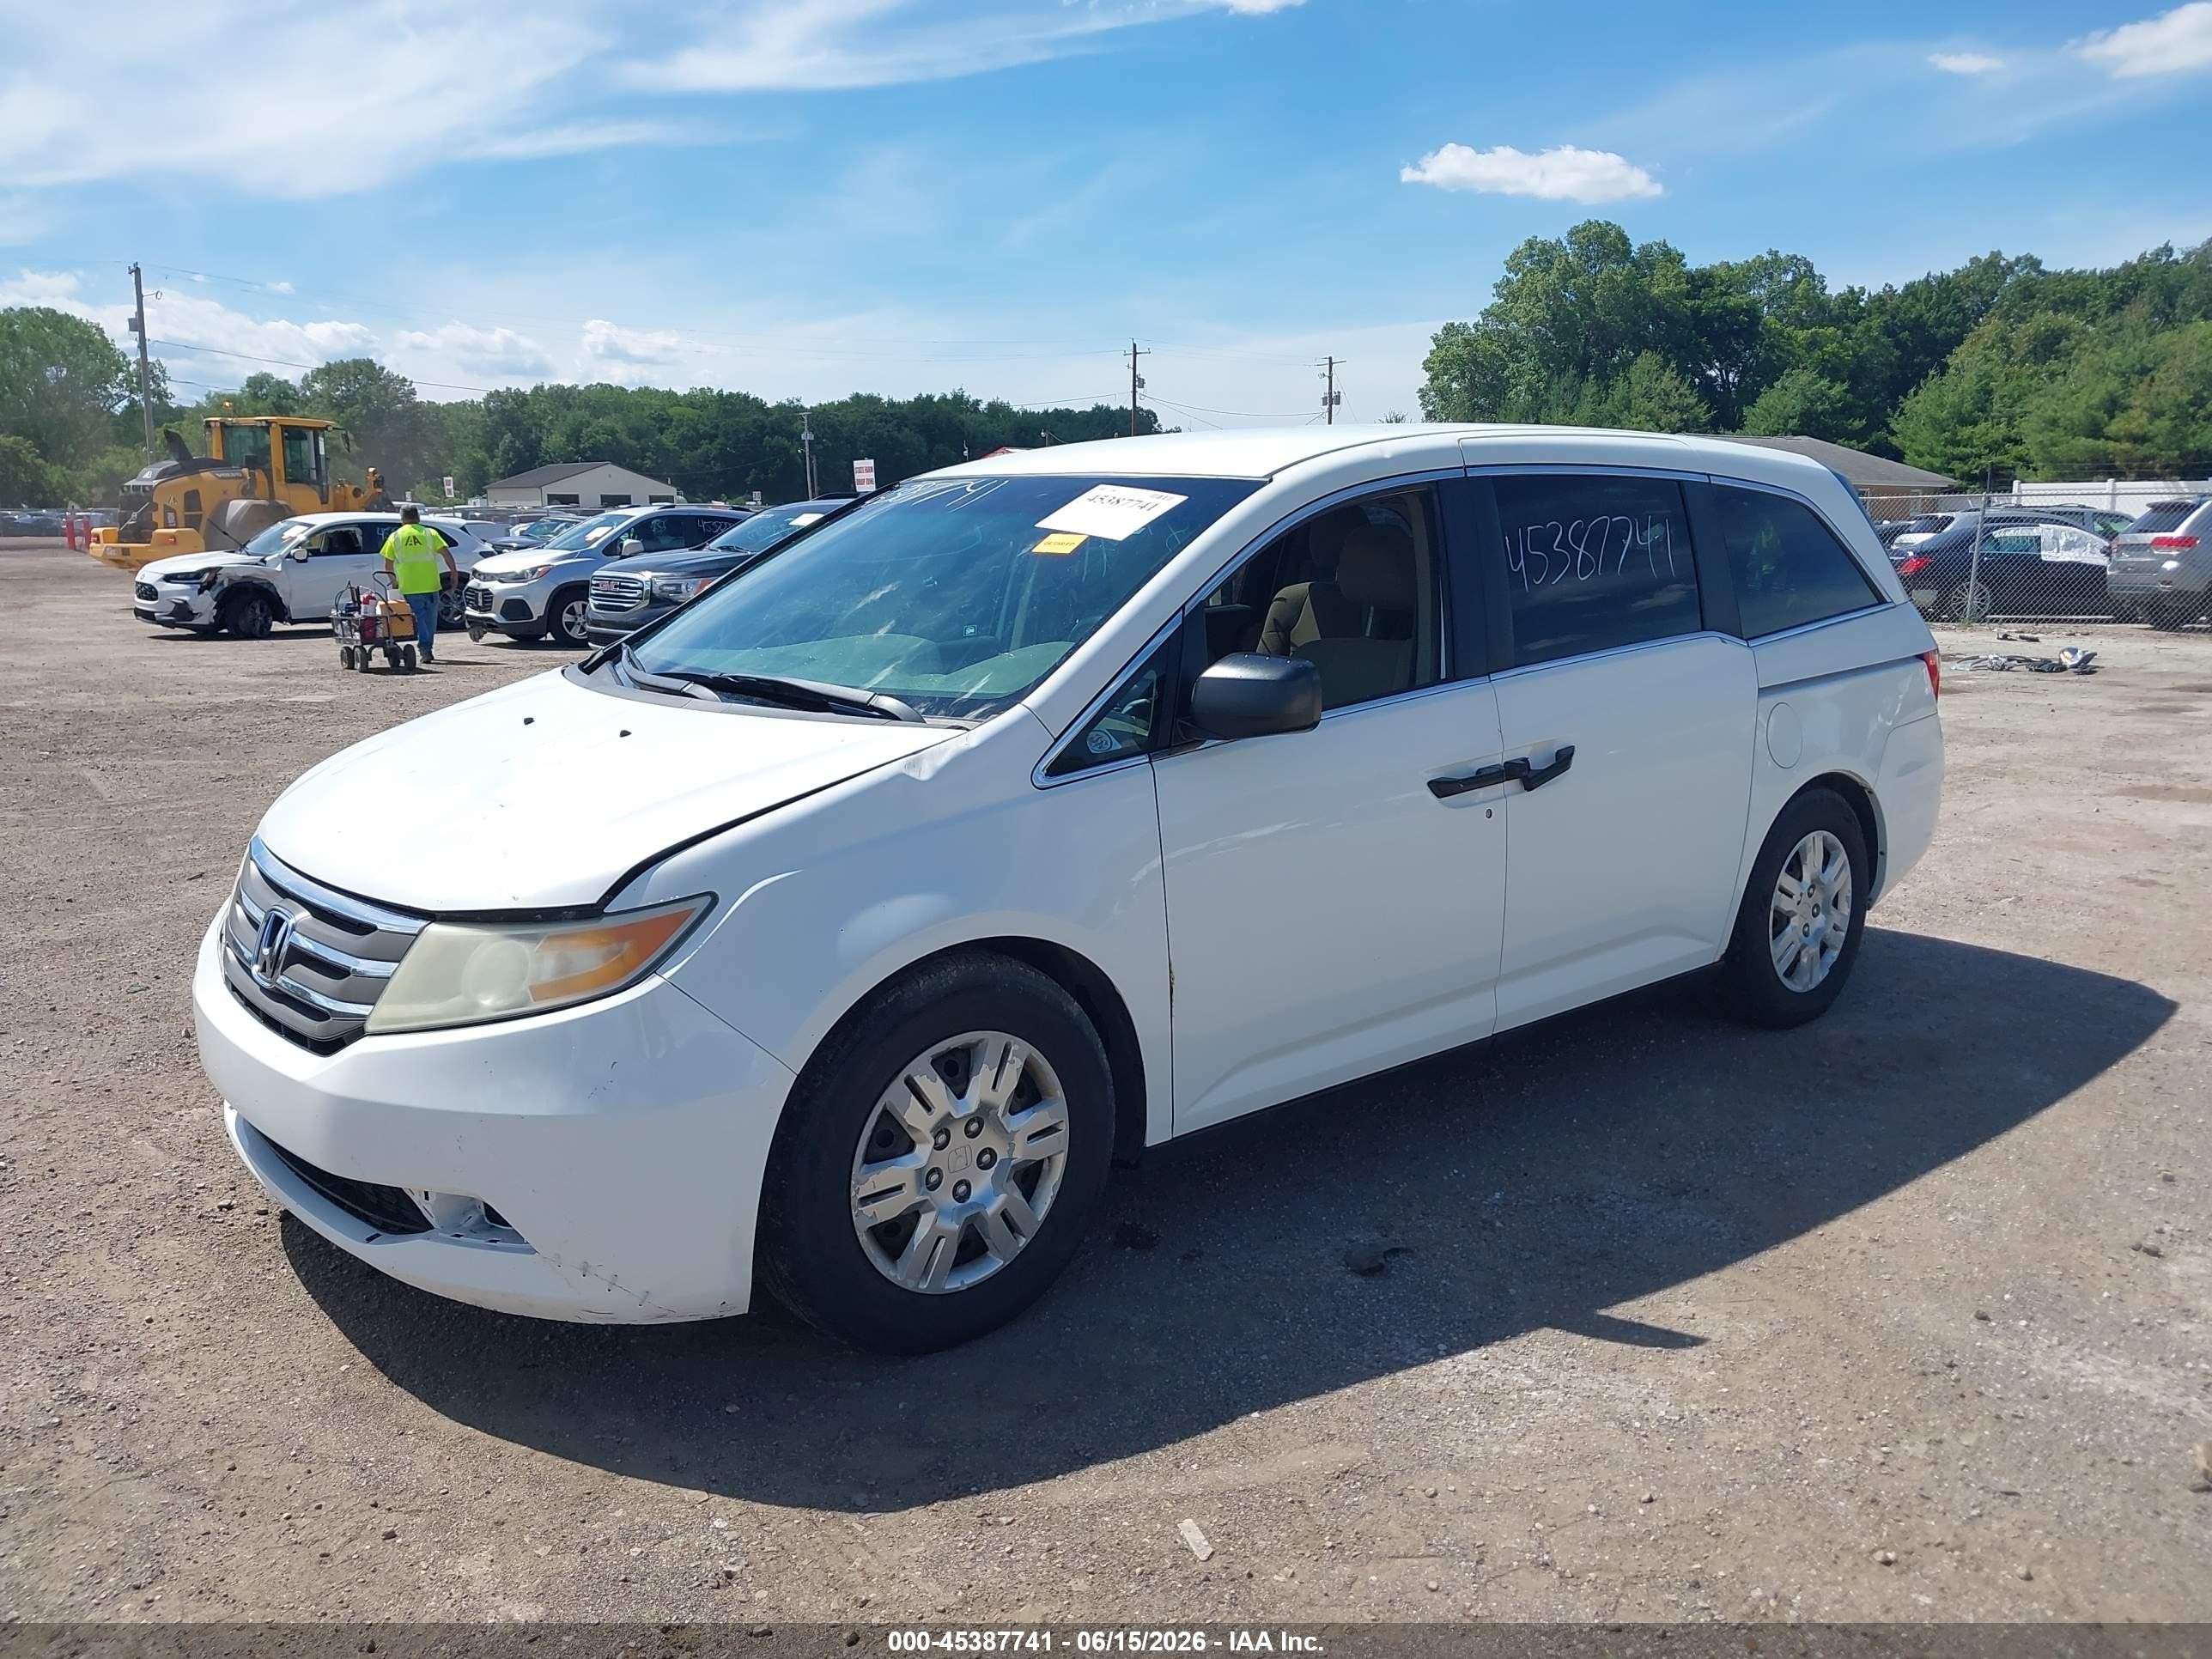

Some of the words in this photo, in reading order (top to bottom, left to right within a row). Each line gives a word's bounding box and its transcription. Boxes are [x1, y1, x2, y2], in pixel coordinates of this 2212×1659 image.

[1087, 494, 1160, 512] 45387741
[1504, 515, 1675, 592] 45387741
[599, 580, 620, 592] GMC
